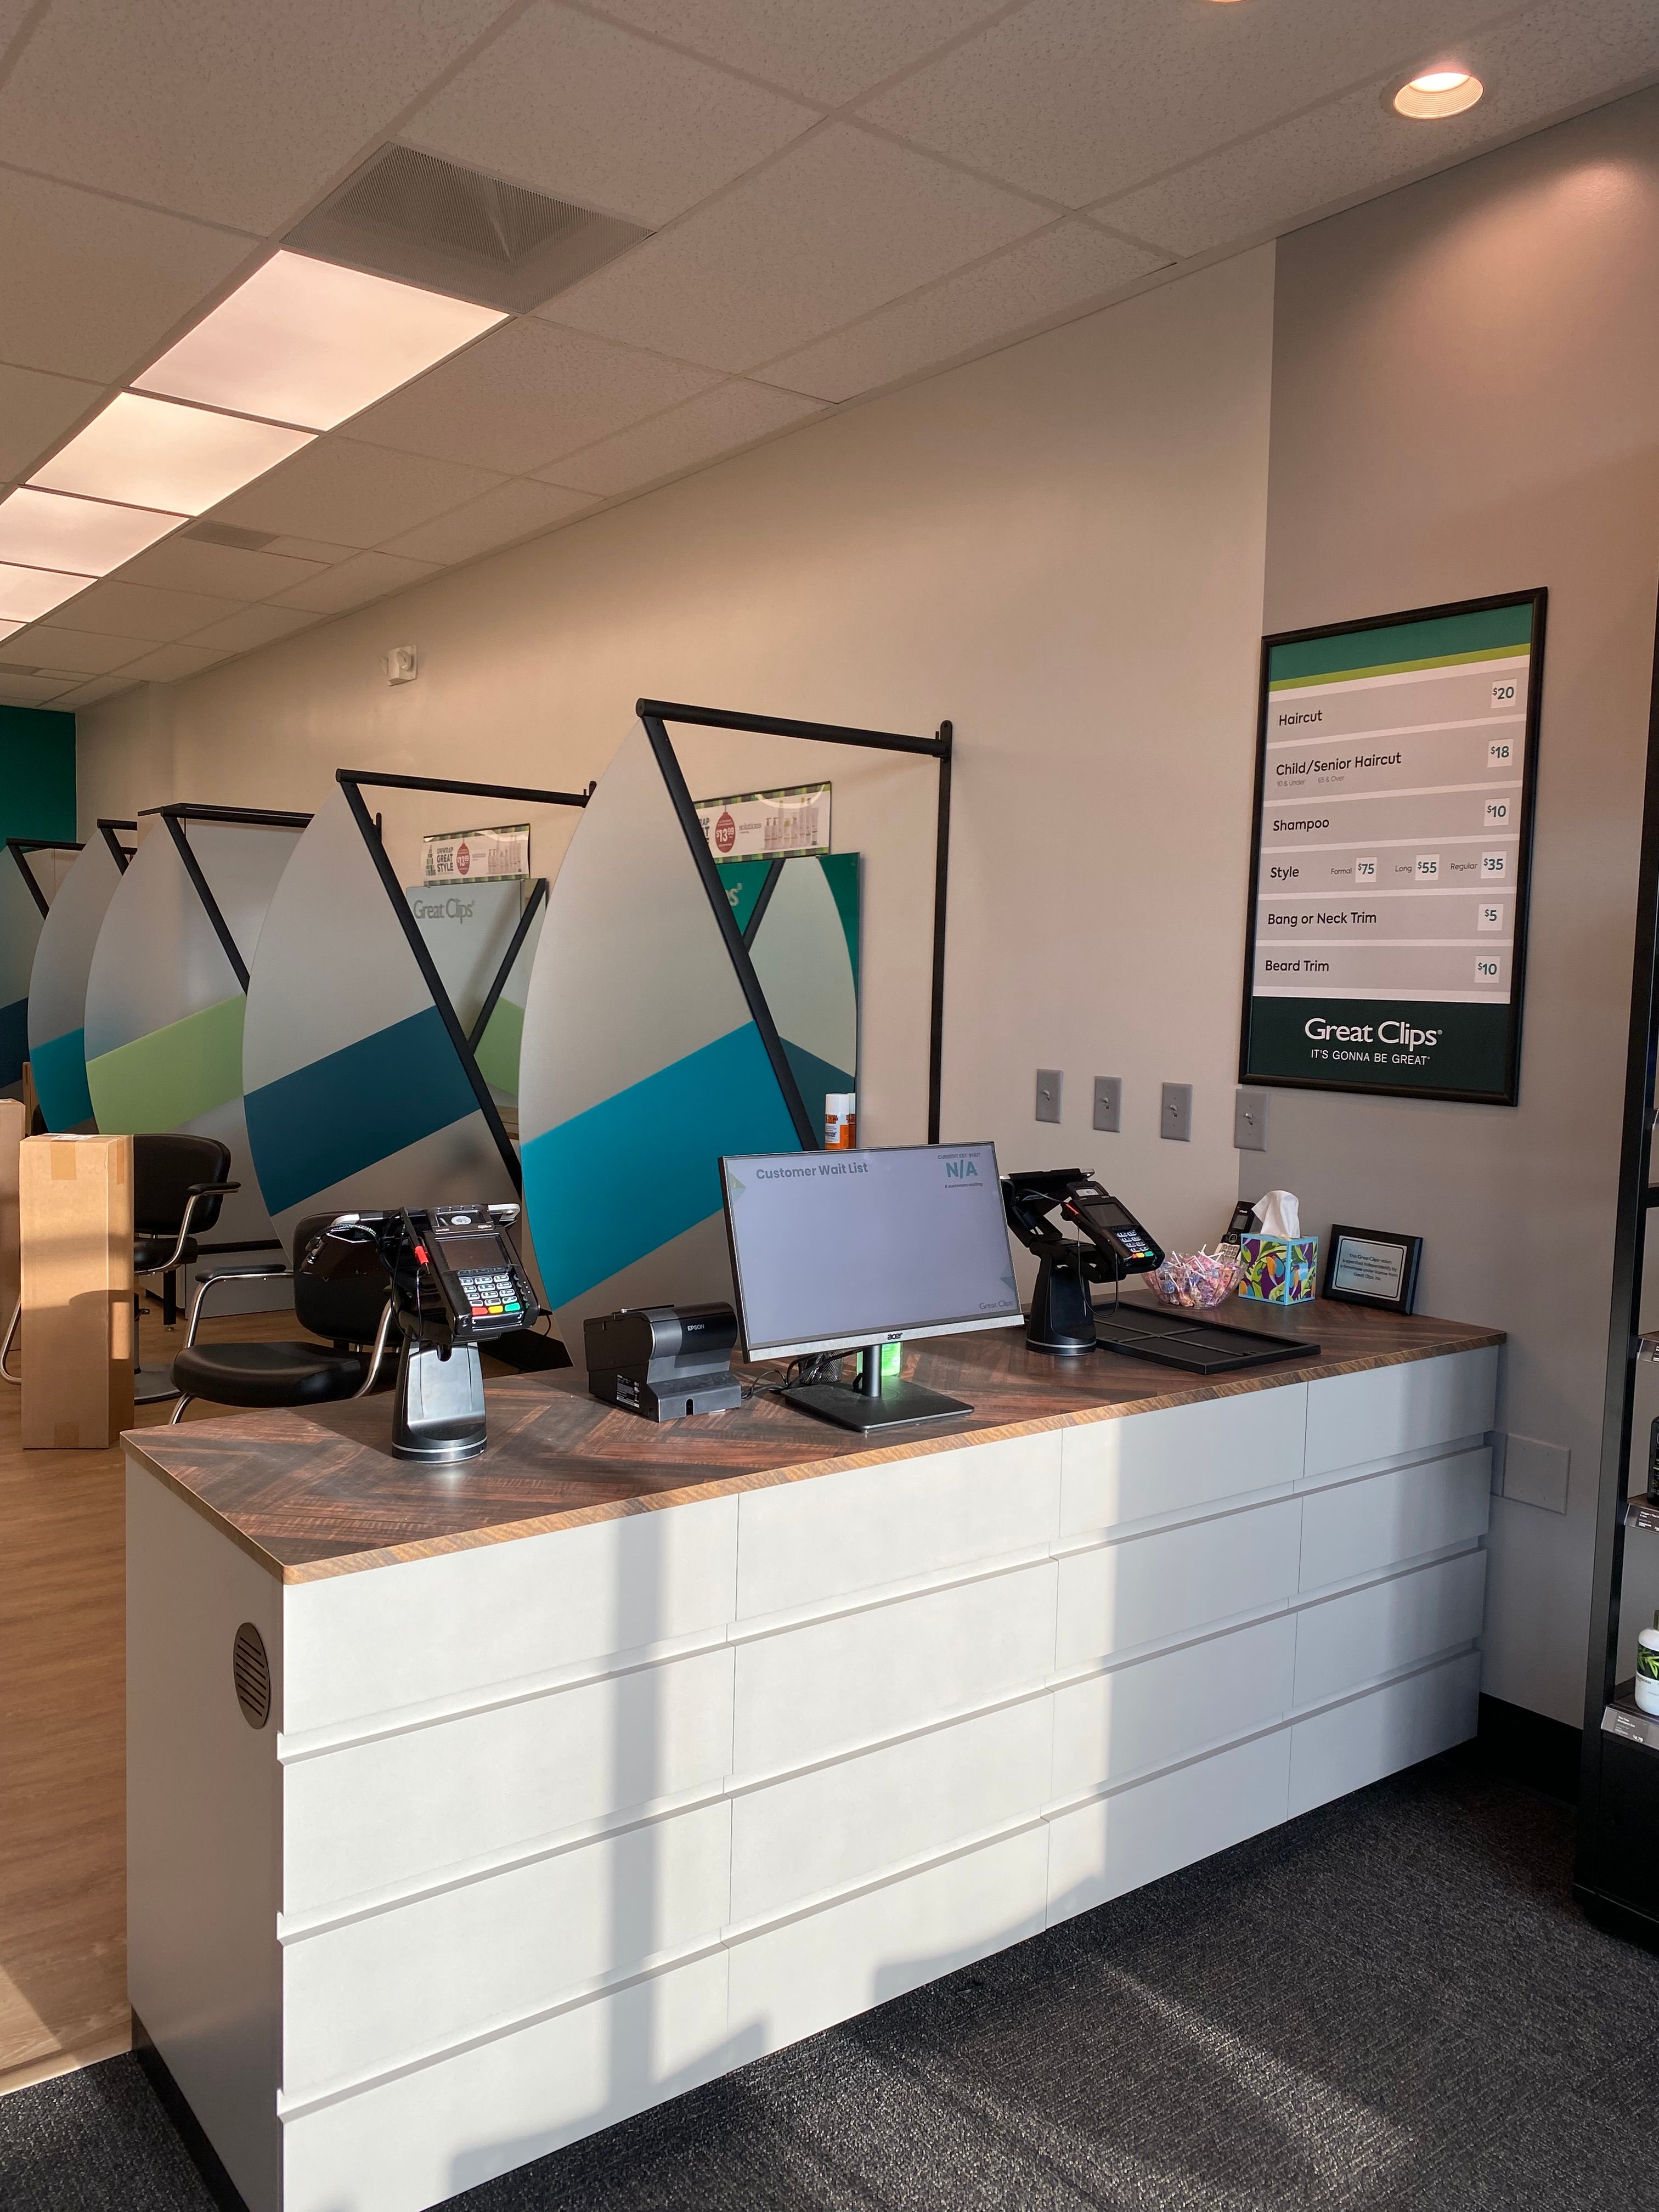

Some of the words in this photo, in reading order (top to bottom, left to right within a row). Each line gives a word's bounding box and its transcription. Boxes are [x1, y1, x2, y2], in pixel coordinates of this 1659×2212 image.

[1492, 686, 1515, 699] $20
[1278, 710, 1323, 726] Haircut
[1490, 746, 1510, 759] $18
[1276, 757, 1352, 776] Child/Senior
[1355, 752, 1402, 768] Haircut
[1487, 804, 1506, 818] $10
[1272, 818, 1330, 833] Shampoo
[437, 854, 453, 863] GREAT
[1450, 862, 1478, 871] Regular
[1483, 858, 1504, 871] $35
[437, 862, 454, 872] STYLE
[1270, 866, 1300, 880] Style
[1330, 867, 1352, 875] Formal
[1357, 863, 1375, 875] $75
[1395, 864, 1412, 874] Long
[1418, 861, 1437, 874] $55
[413, 899, 444, 919] Great
[1484, 909, 1497, 922] $5
[1267, 913, 1298, 927] Bang
[1301, 915, 1313, 924] or
[1317, 912, 1347, 924] Neck
[1350, 912, 1377, 924] Trim
[1265, 960, 1300, 972] Beard
[1304, 960, 1329, 972] Trim
[1477, 962, 1497, 976] $10
[1305, 1018, 1373, 1042] Great
[1311, 1049, 1329, 1059] IT'S
[1332, 1051, 1370, 1062] GONNA
[1374, 1053, 1387, 1063] BE
[756, 1165, 816, 1180] Customer
[819, 1164, 847, 1176] Wait
[848, 1162, 868, 1173] List
[946, 1159, 978, 1178] N/A
[887, 1332, 903, 1340] acer
